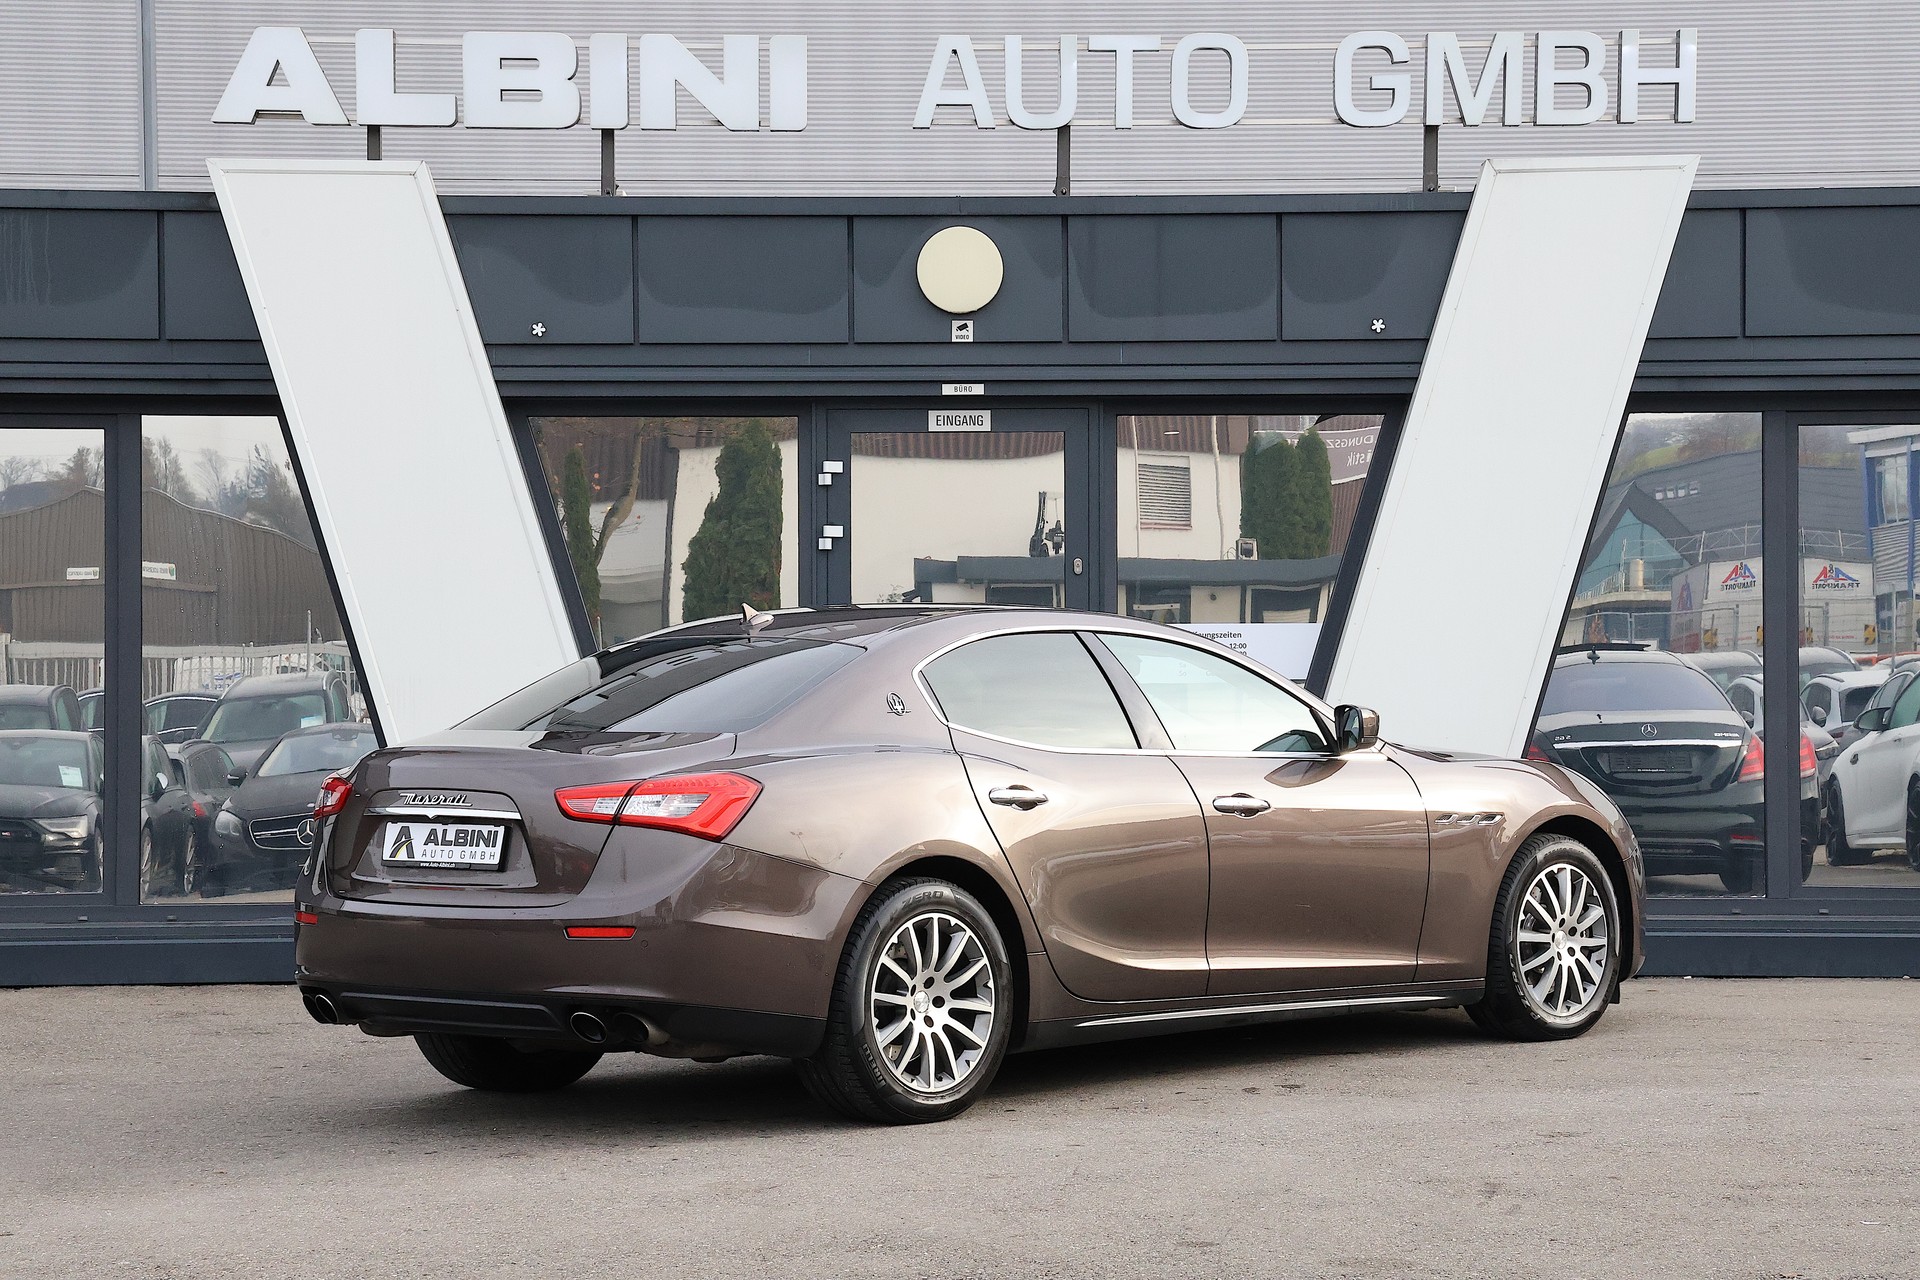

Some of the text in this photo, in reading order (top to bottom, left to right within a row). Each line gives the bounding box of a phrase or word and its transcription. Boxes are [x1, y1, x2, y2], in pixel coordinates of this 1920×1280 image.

[211, 26, 1698, 132] ALBINI AUTO GMBH
[954, 384, 973, 393] BÜRO
[936, 414, 984, 427] EINGANG
[400, 792, 473, 807] Maserati
[424, 828, 499, 848] ALBINI
[421, 849, 496, 861] AUTO GMBH
